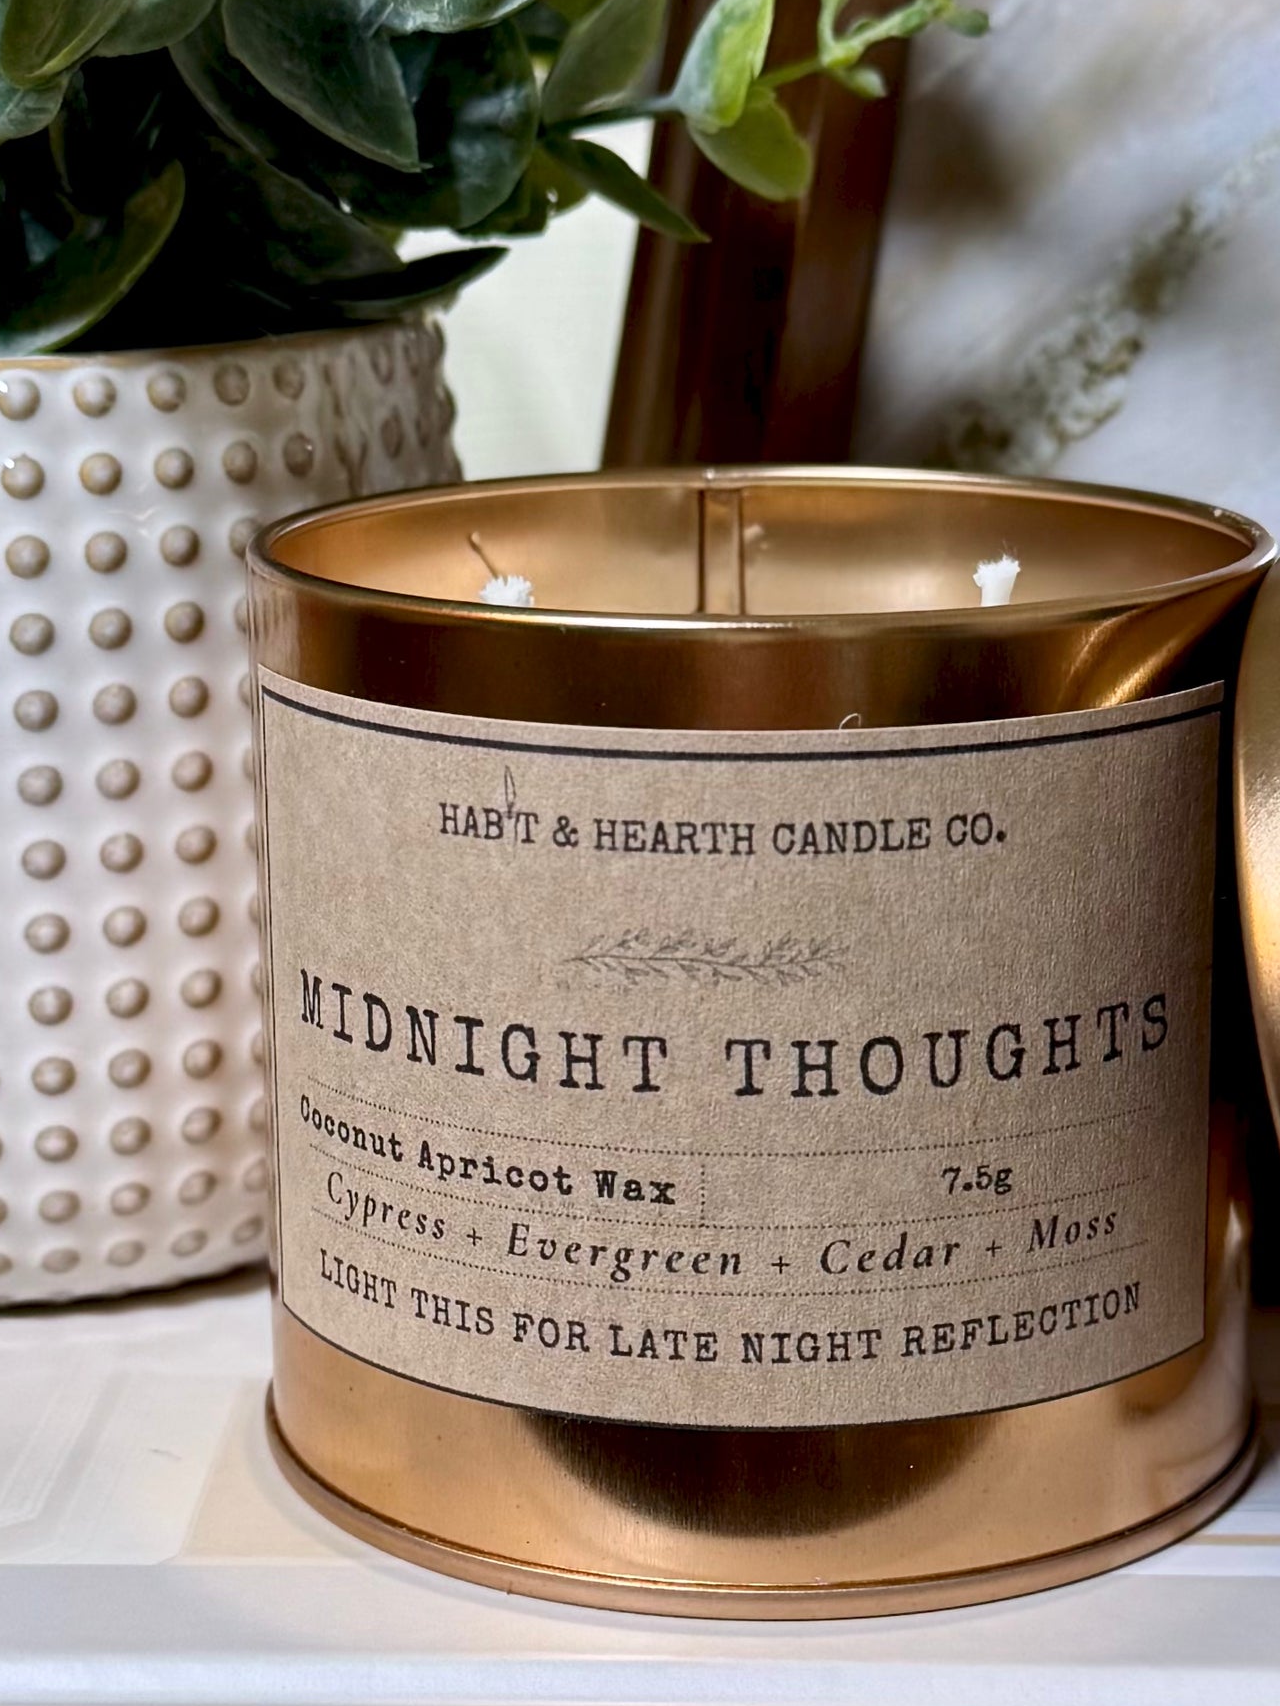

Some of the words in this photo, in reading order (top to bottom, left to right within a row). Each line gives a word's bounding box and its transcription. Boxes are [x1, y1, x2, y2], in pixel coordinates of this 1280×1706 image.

[552, 815, 579, 847] &
[594, 818, 756, 855] HEARTH
[772, 817, 931, 855] CANDLE
[945, 812, 1008, 846] CO.
[300, 968, 669, 1093] MIDNIGHT
[724, 992, 1172, 1098] THOUGHTS
[300, 1094, 404, 1162] Coconut
[417, 1141, 574, 1196] Apricot
[592, 1169, 676, 1206] Wax
[942, 1165, 1014, 1194] 7.5g
[327, 1171, 445, 1241] Cypress
[467, 1228, 483, 1247] +
[507, 1222, 742, 1283] Evergreen
[771, 1255, 791, 1275] +
[820, 1231, 961, 1275] Cedar
[985, 1239, 1003, 1259] +
[1026, 1210, 1118, 1254] Moss
[320, 1248, 397, 1309] LIGHT
[410, 1287, 495, 1336] THIS
[512, 1312, 590, 1353] FOR
[610, 1324, 718, 1363] LATE
[741, 1329, 882, 1365] NIGHT
[901, 1281, 1141, 1358] REFLECTION
